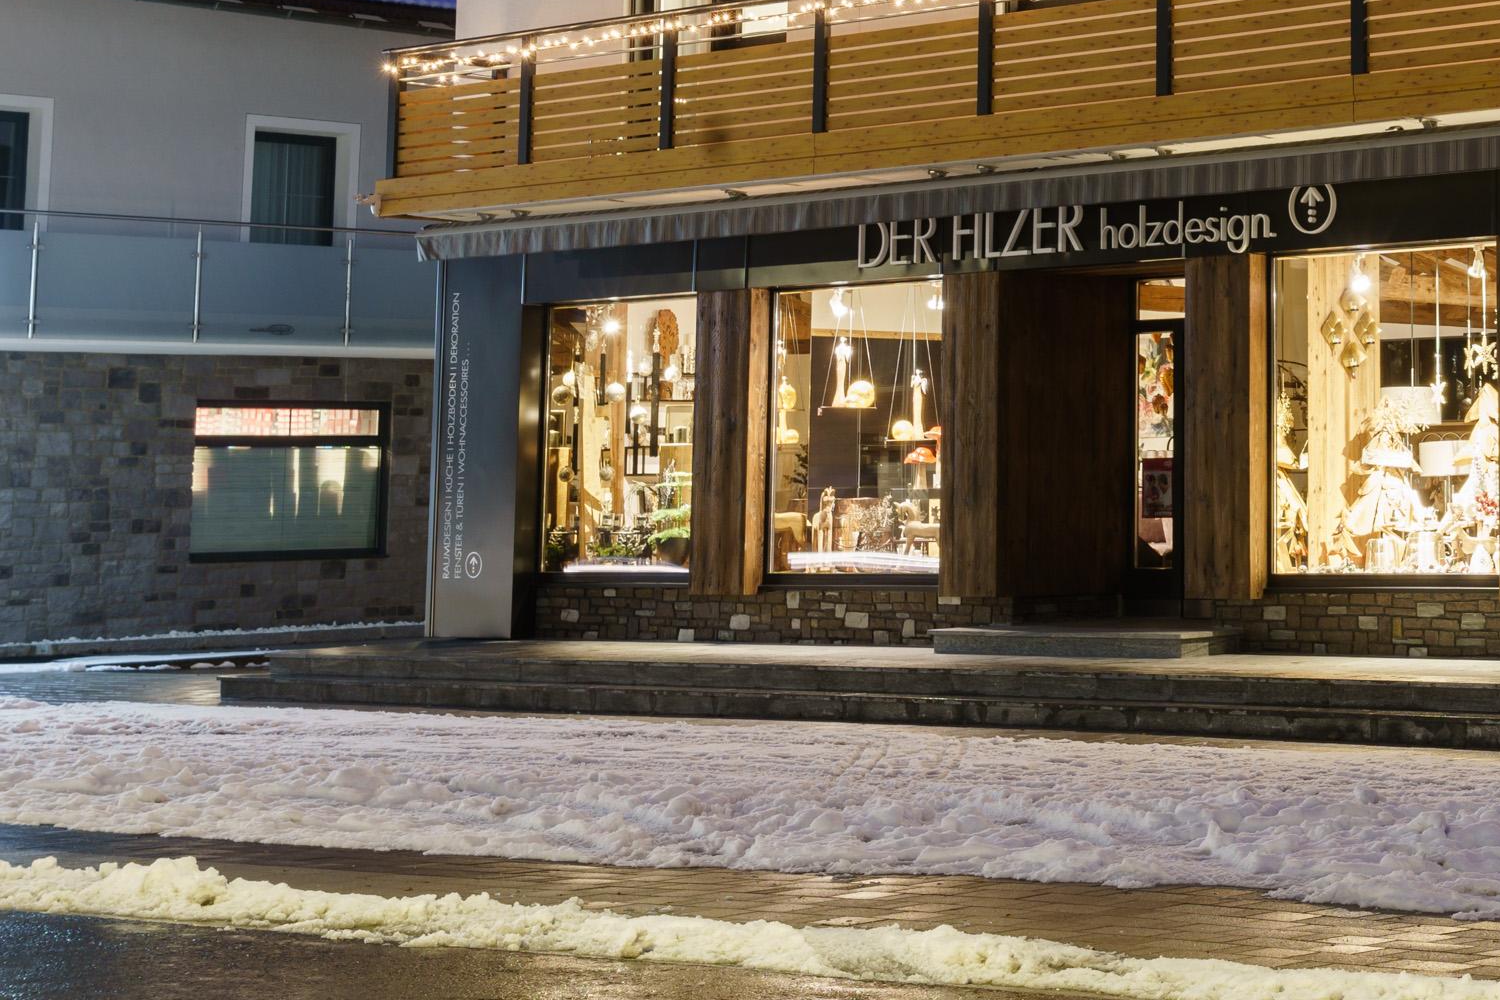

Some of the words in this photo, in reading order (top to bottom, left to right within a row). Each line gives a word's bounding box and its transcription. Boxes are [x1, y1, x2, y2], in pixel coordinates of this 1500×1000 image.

[857, 216, 937, 268] DER
[450, 292, 461, 364] DEKORATION
[447, 372, 457, 446] HOLZBÖDEN
[445, 453, 454, 493] KÜCHE
[456, 482, 465, 520] TÜREN
[442, 501, 453, 579] RAUMDESIGN
[454, 534, 463, 579] FENSTER
